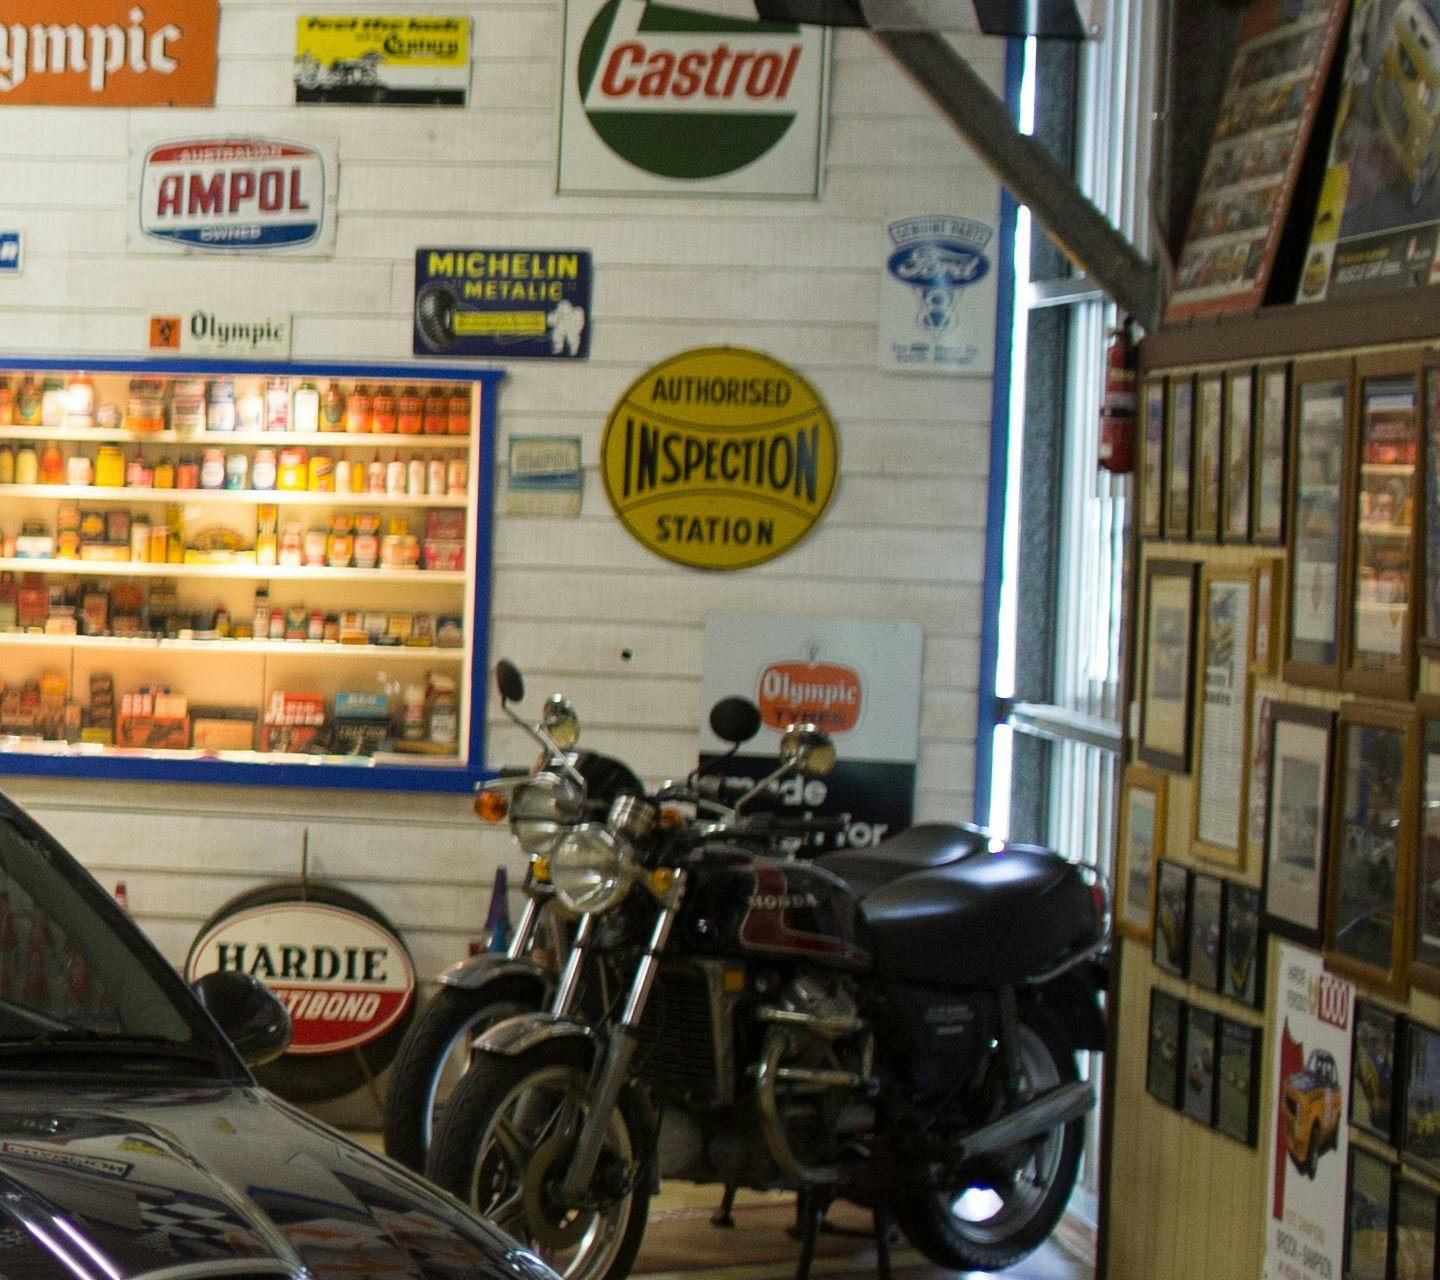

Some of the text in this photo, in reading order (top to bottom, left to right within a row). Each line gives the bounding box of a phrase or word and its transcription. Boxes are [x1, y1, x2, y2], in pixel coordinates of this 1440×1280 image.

[599, 40, 804, 103] Castrol
[155, 166, 310, 219] AMPOL
[200, 225, 262, 242] OWNED
[428, 250, 579, 280] MICHELIN
[898, 247, 981, 280] Ford
[189, 309, 286, 344] Olympic
[651, 373, 792, 408] AUTHORISED
[622, 415, 820, 505] INSPECTION
[654, 515, 776, 547] STATION
[761, 670, 858, 708] Olympic
[774, 707, 847, 726] TYRES
[747, 893, 819, 910] HONDA
[216, 941, 389, 983] HARDIE
